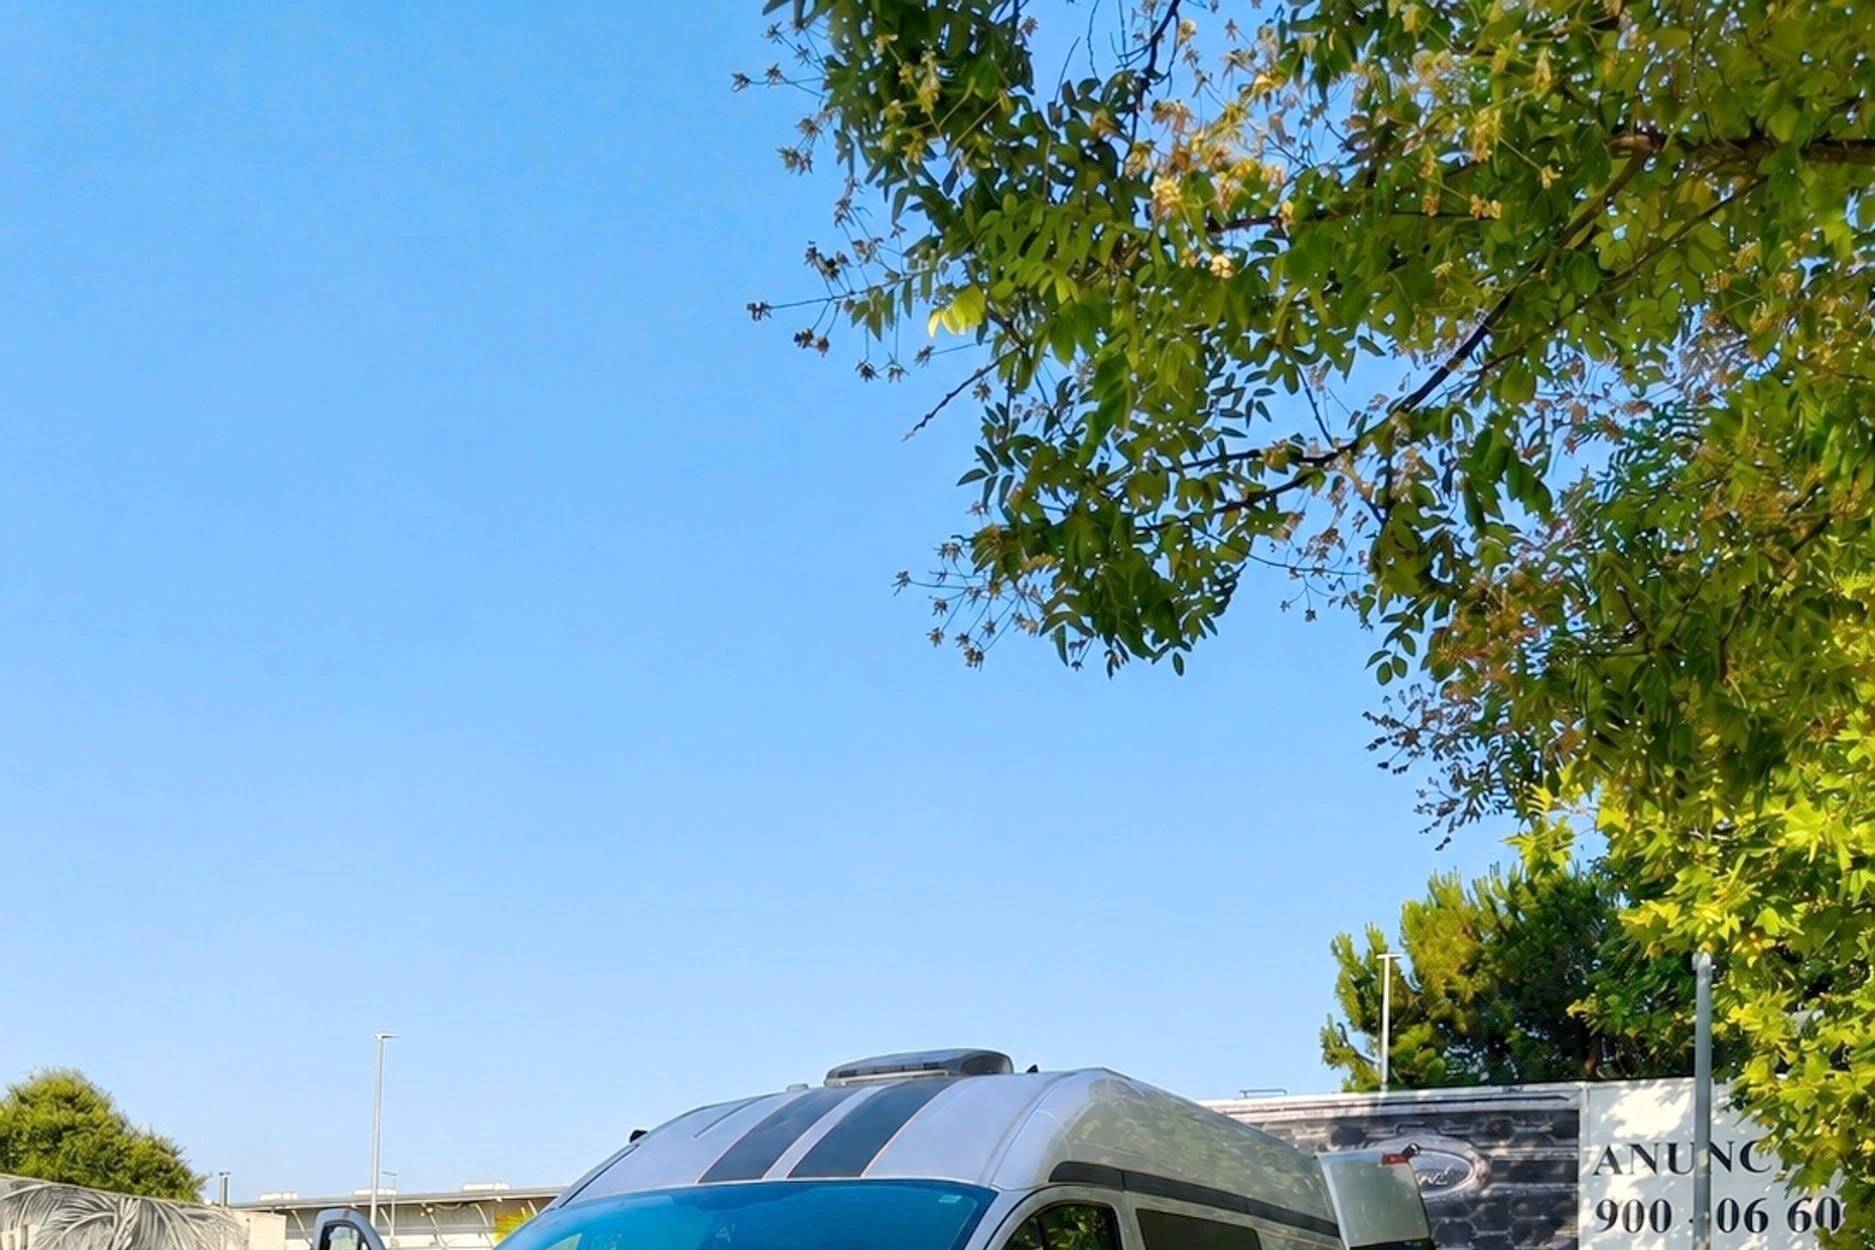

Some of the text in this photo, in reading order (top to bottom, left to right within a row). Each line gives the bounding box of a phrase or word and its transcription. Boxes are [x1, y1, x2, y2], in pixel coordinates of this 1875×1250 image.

[1592, 1140, 1784, 1176] ANUNC
[1595, 1196, 1846, 1234] 900 06 60
